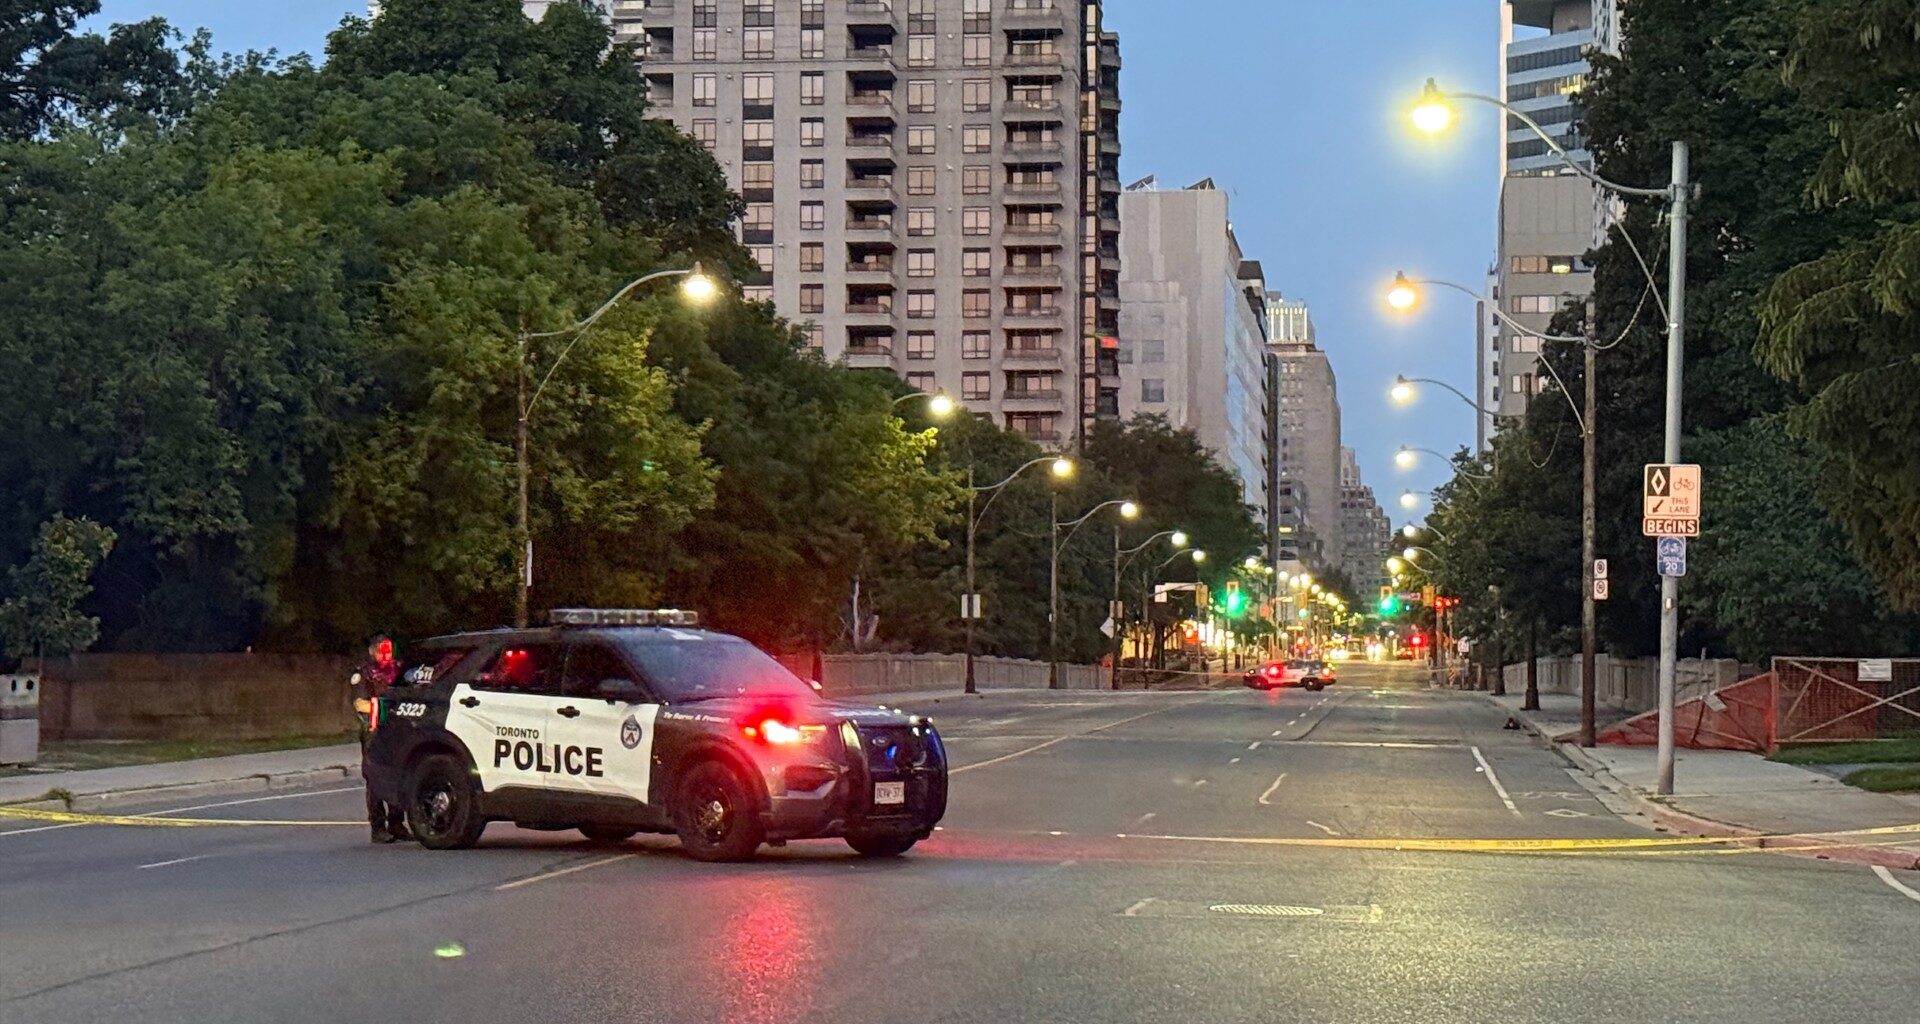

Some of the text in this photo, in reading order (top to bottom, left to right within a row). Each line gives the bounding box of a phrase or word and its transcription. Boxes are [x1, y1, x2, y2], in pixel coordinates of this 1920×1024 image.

[1671, 497, 1689, 505] THIS
[1646, 520, 1696, 533] BEGINS
[396, 702, 427, 717] 5323
[495, 726, 539, 740] TORONTO
[493, 739, 604, 777] POLICE
